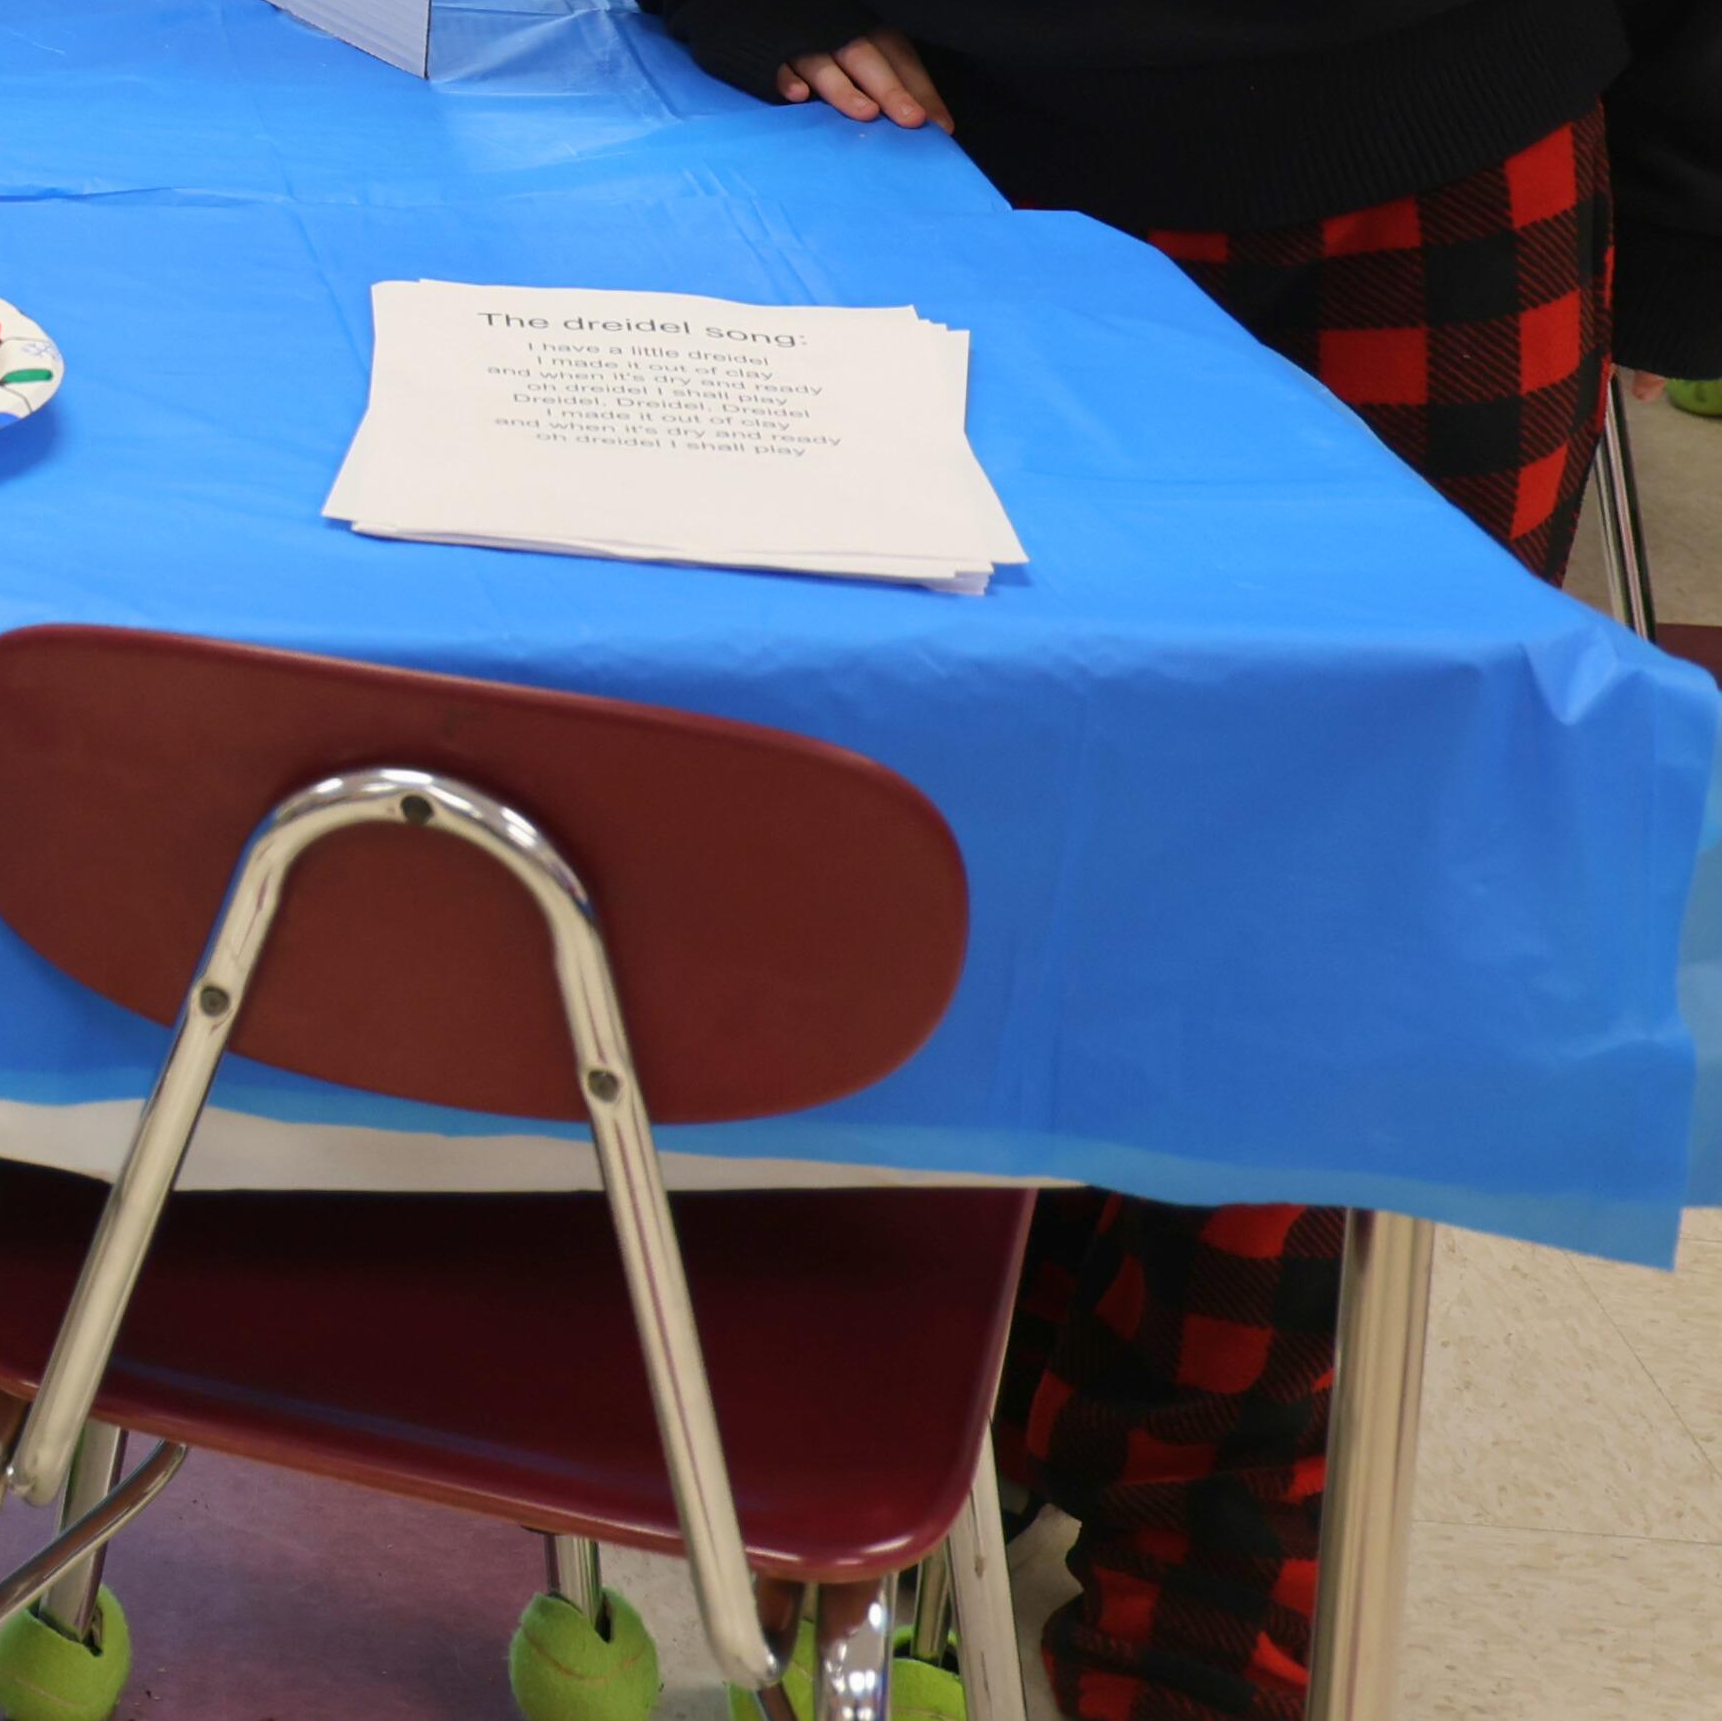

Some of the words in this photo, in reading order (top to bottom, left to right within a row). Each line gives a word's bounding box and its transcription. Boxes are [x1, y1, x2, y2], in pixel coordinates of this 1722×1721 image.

[476, 313, 549, 328] The
[564, 317, 691, 334] dreidel
[705, 327, 808, 348] song:
[543, 342, 600, 353] have
[609, 347, 622, 355] a
[632, 346, 679, 358] little
[688, 350, 768, 366] dreidel
[488, 367, 530, 377] and
[539, 371, 604, 380] when
[613, 372, 645, 382] it's
[654, 375, 691, 385] dry
[701, 379, 745, 389] and
[755, 384, 822, 396] ready
[552, 358, 618, 369] made
[628, 361, 639, 369] it
[649, 364, 685, 372] out
[695, 367, 717, 375] of
[726, 368, 773, 381] clay
[527, 383, 556, 391] oh
[565, 384, 647, 394] dreidel
[673, 389, 730, 399] shall
[739, 394, 787, 406] play
[562, 411, 630, 419] made
[640, 412, 651, 421] it
[661, 415, 700, 424] out
[709, 416, 732, 425] of
[742, 418, 790, 431] clay
[722, 404, 810, 418] Dreidel
[495, 418, 539, 428] and
[549, 422, 615, 432] when
[625, 425, 658, 435] it's
[667, 427, 705, 438] dry
[715, 431, 762, 440] and
[771, 434, 841, 446] ready
[536, 433, 567, 441] oh
[576, 435, 660, 447] dreidel
[687, 441, 745, 452] shall
[754, 445, 805, 457] play
